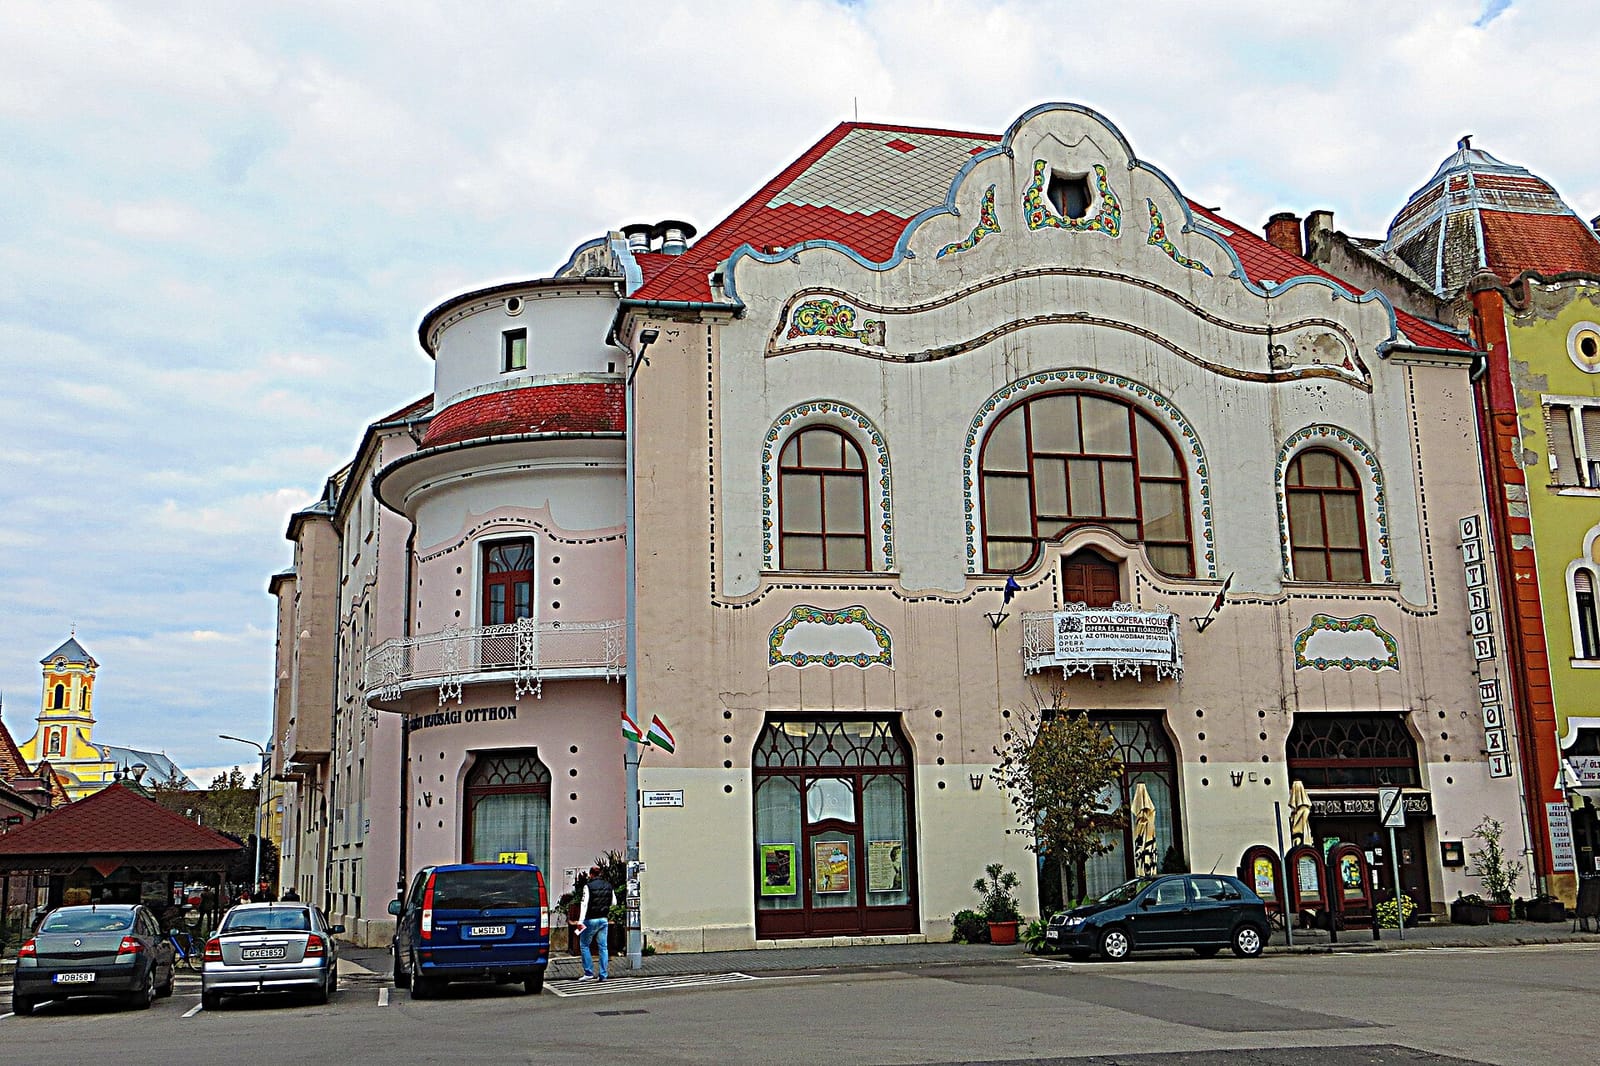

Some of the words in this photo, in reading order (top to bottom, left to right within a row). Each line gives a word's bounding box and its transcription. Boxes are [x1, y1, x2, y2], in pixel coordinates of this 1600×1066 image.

[1085, 616, 1114, 624] ROYAL
[1116, 616, 1143, 625] OPERA
[465, 706, 517, 722] OTTHON
